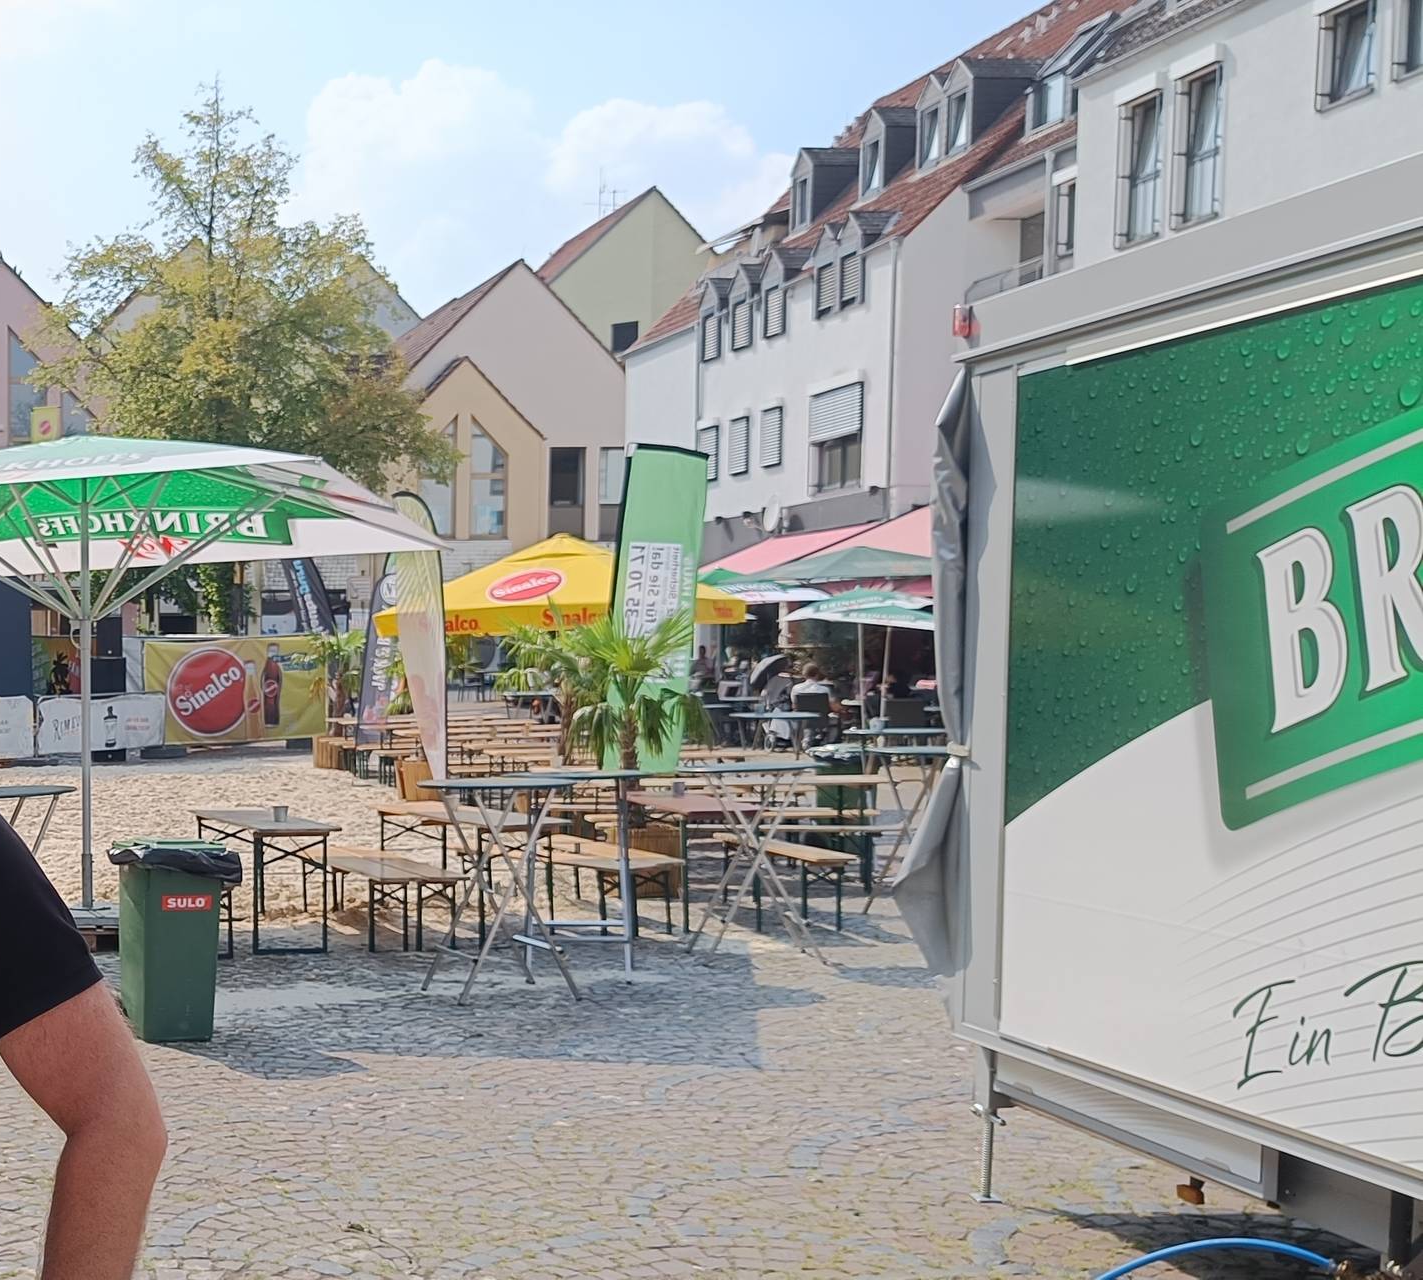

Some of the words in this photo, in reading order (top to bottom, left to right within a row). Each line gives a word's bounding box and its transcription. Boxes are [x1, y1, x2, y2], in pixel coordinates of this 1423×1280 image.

[493, 574, 560, 598] Sinalco
[445, 614, 479, 632] alco
[175, 666, 241, 716] Sinalco
[167, 897, 206, 908] SULO
[1233, 979, 1332, 1090] Ein
